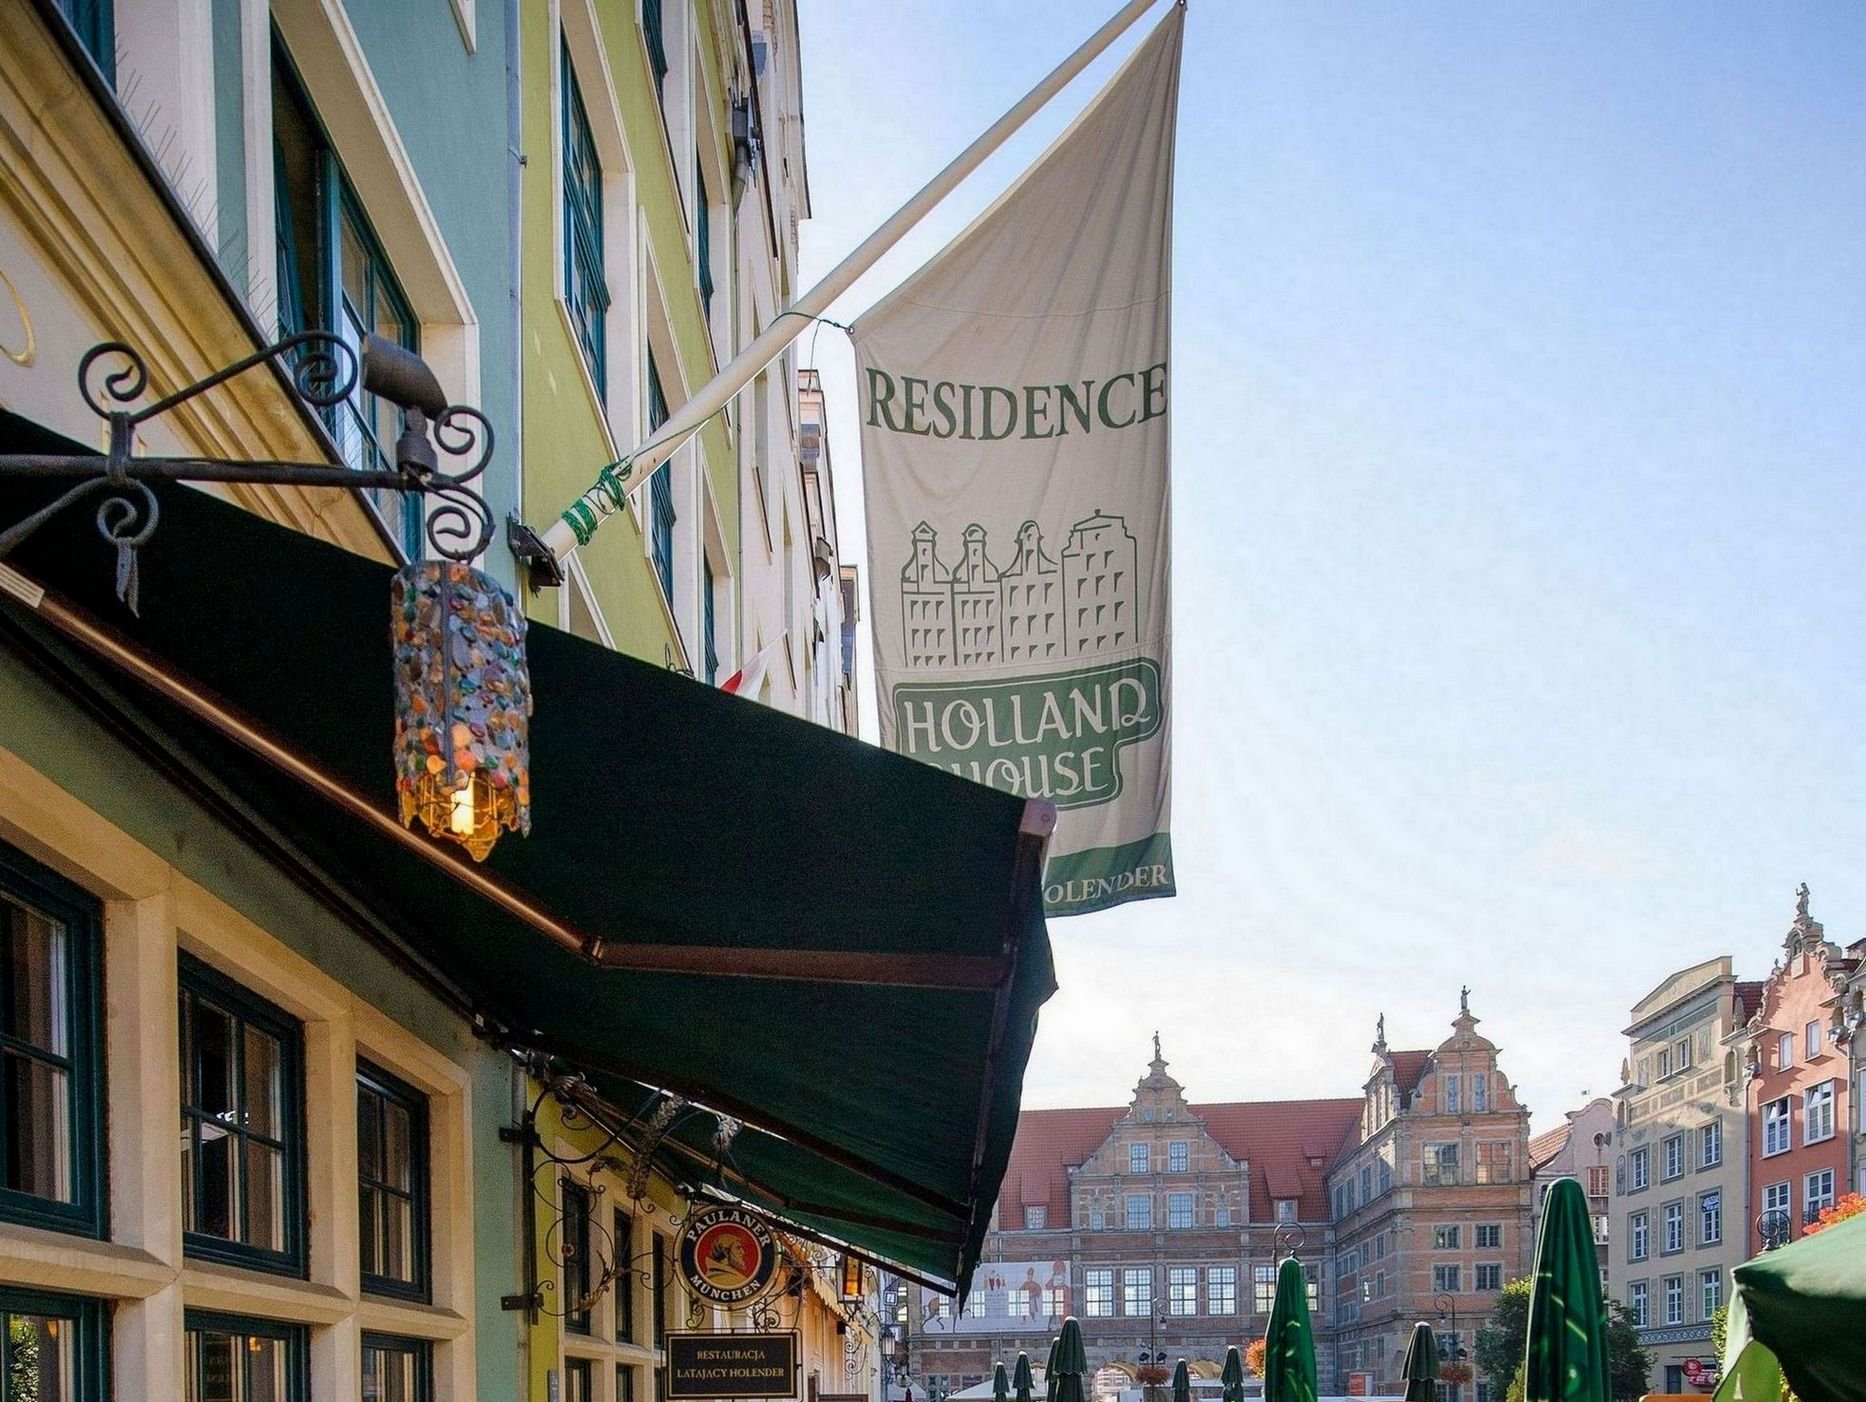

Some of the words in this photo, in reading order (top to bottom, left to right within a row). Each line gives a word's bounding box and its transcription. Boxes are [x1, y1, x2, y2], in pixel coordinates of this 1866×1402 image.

[865, 363, 1168, 441] RESIDENCE
[904, 677, 1151, 754] HOLLAND
[1044, 864, 1168, 904] OLENDER
[686, 1210, 771, 1247] PAULANER
[696, 1350, 765, 1361] RESTAURACJA
[729, 1367, 785, 1378] HOLENDER
